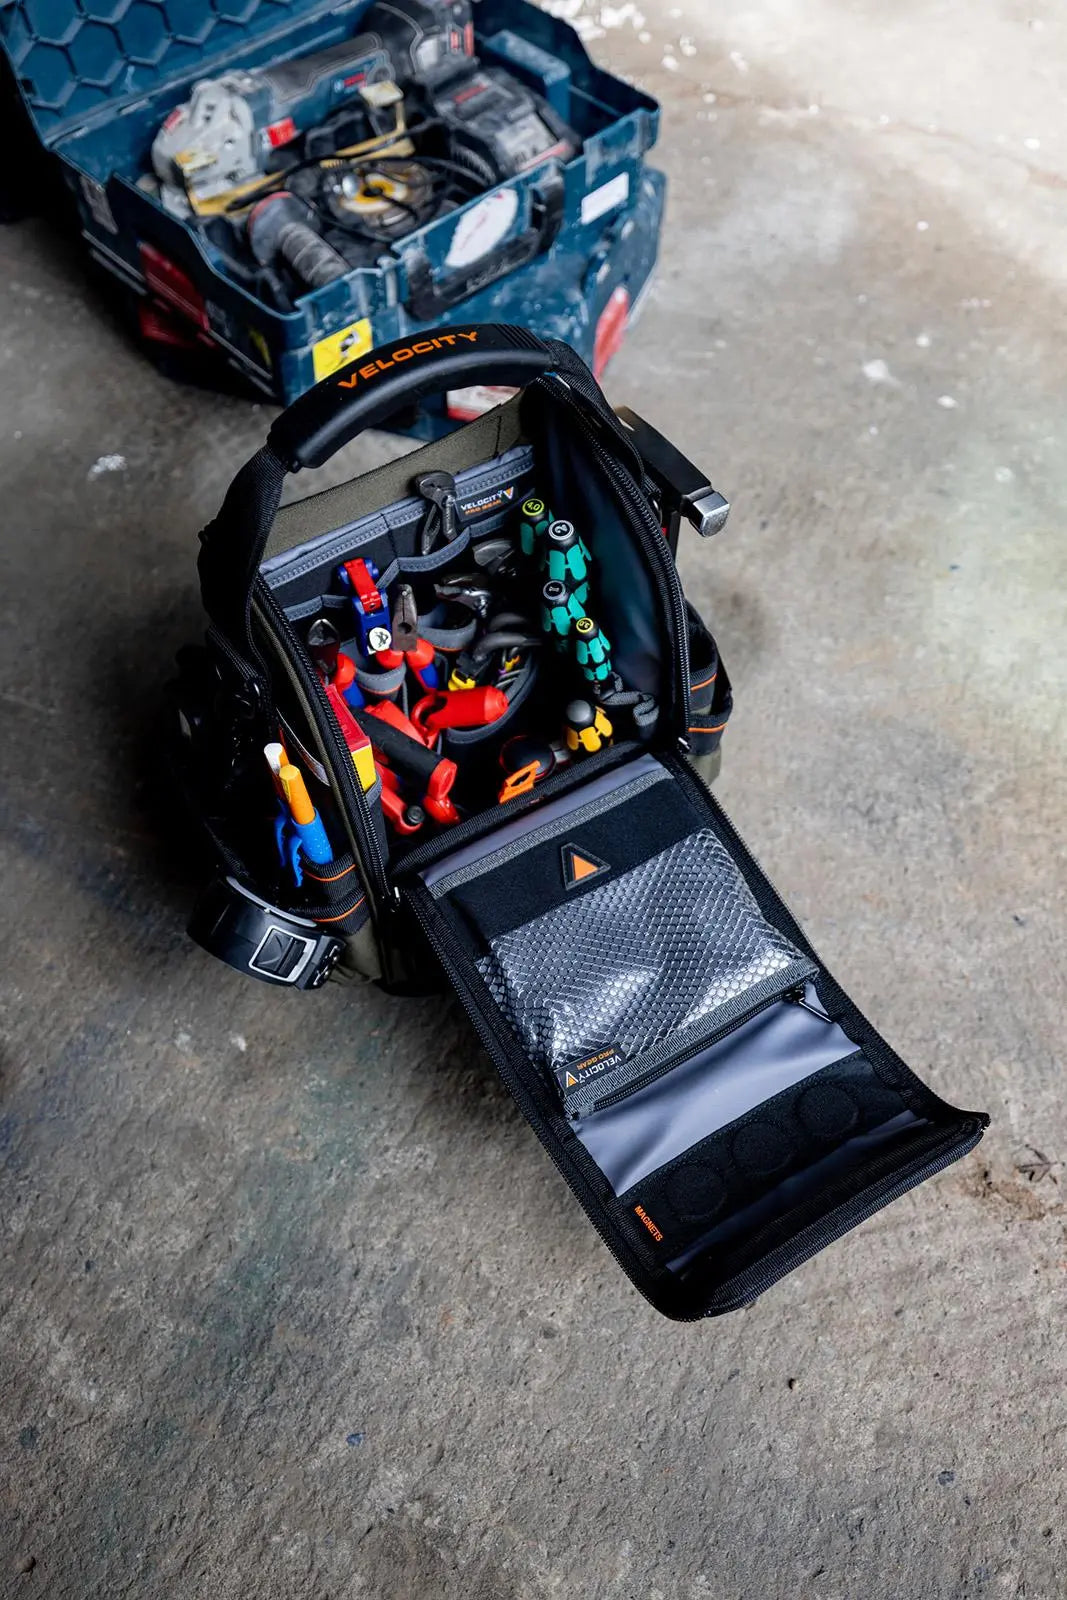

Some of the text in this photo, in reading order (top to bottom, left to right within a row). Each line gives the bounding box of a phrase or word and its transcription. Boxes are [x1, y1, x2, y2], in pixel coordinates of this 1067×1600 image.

[337, 331, 478, 388] VELOCITY
[460, 490, 503, 511] VELOCITY
[576, 1048, 615, 1071] PRO GEAR
[578, 1054, 622, 1079] VELOCITY
[634, 1205, 663, 1241] MAGNETS
